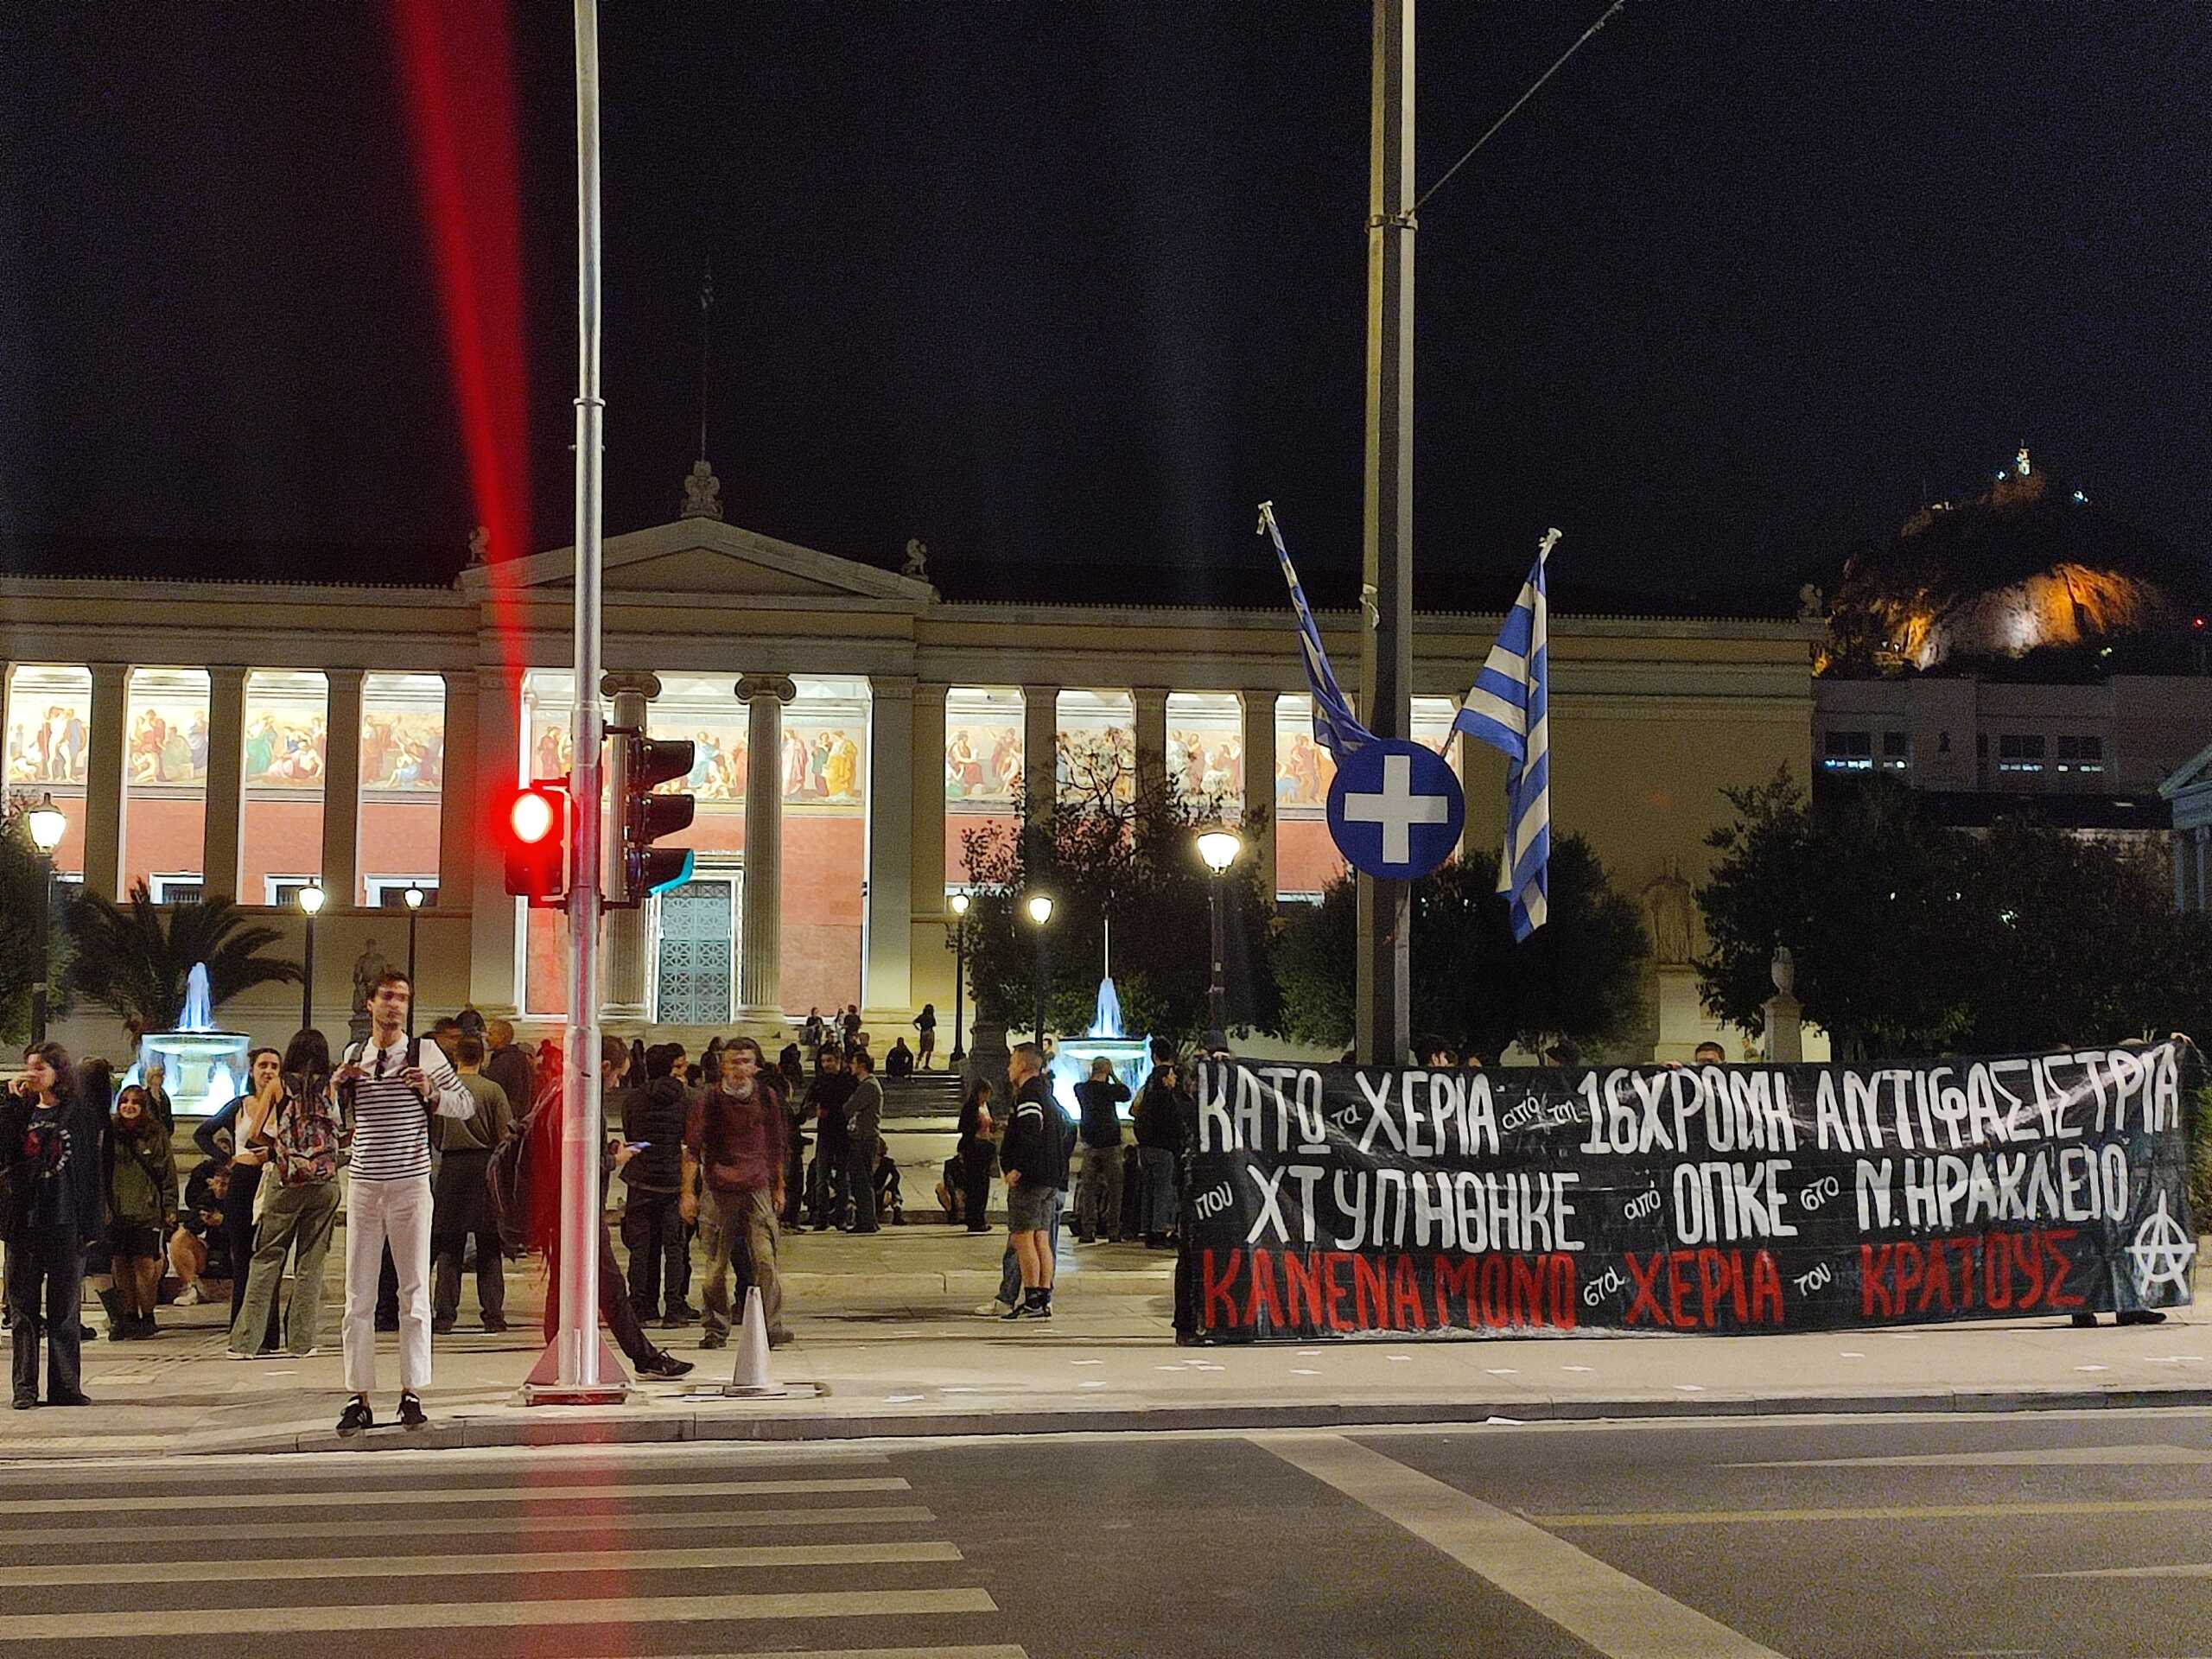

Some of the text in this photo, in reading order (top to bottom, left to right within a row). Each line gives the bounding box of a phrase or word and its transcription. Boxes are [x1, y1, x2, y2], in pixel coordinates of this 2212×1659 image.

[1355, 1071, 1500, 1157] ΧΕΡΙΑ
[1577, 1065, 1797, 1154] 16ΧΡΟΝΗ
[1816, 1044, 2178, 1153] ΑΝΤΙΦΑΣΙΣΤΡΙΑ
[1245, 1164, 1586, 1253] ΧΤΥΠΗΘΗΚΕ
[1673, 1160, 1798, 1244] ΟΠΚΕ
[1202, 1248, 1427, 1332] ΚΑΝΕΝΑ
[1433, 1251, 1577, 1331] ΜΟΝΟ
[1624, 1247, 1784, 1327] ΧΕΡΙΑ
[1860, 1230, 2086, 1317] ΚΡΑΤΟΥΣ
